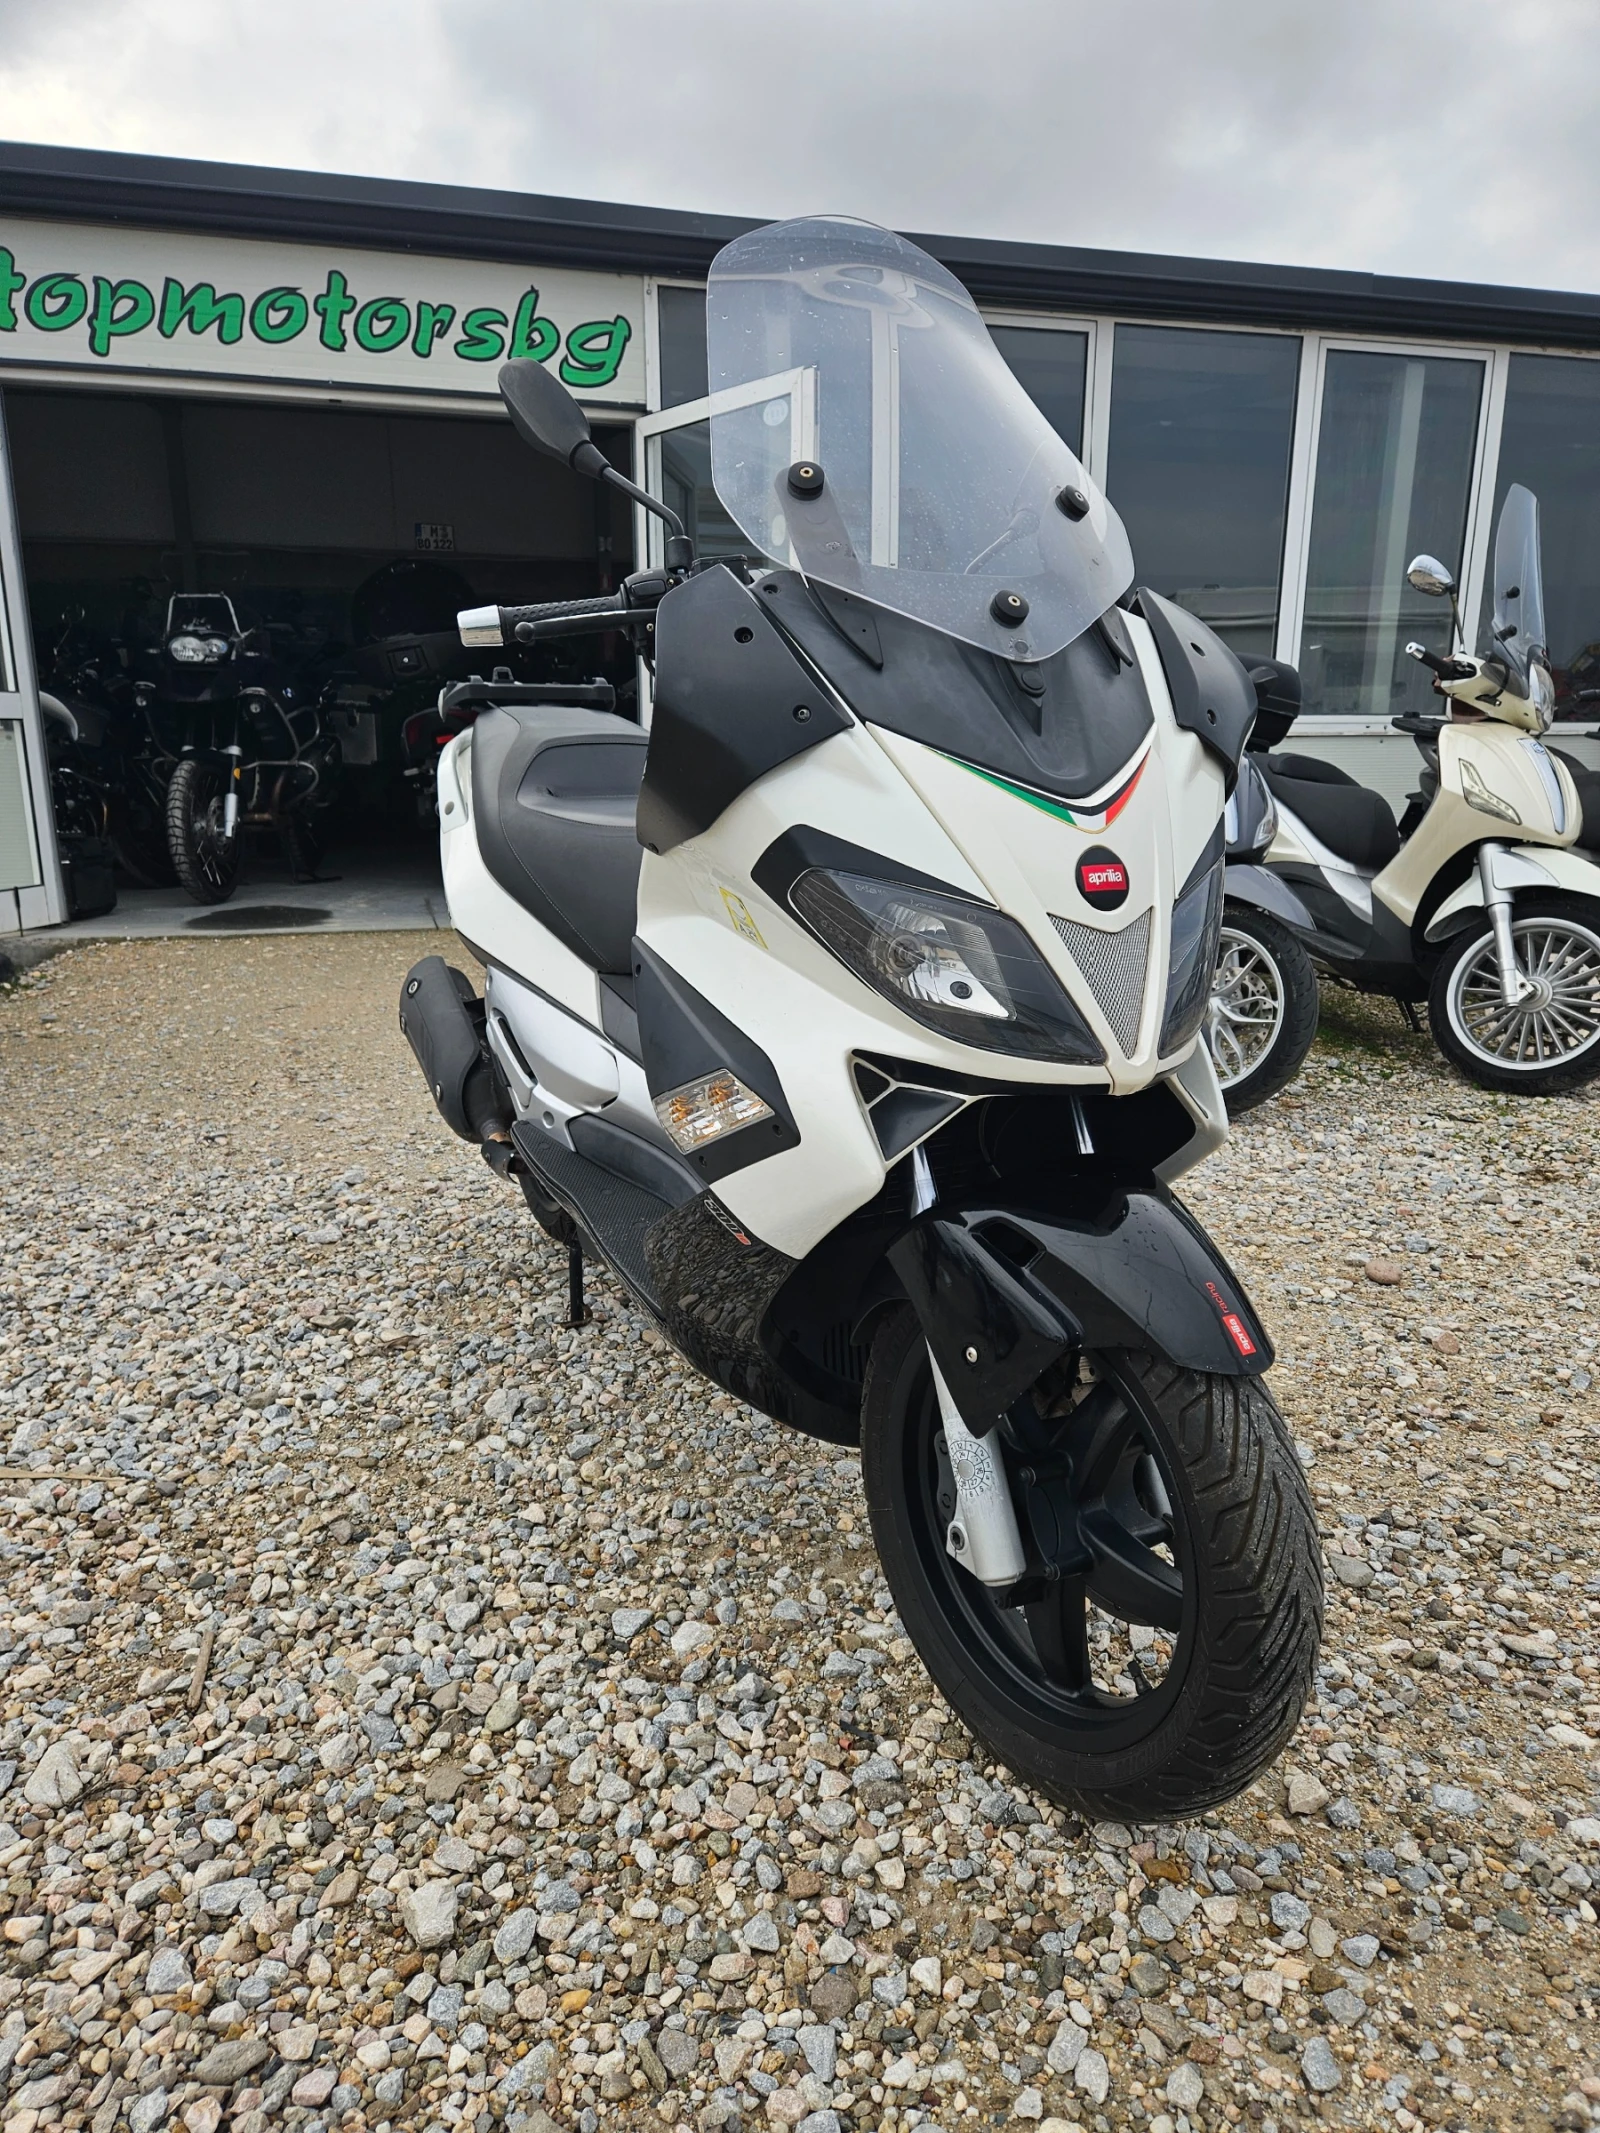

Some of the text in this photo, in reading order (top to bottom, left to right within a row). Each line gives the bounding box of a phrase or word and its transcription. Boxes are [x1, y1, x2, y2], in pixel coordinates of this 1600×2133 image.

[0, 246, 632, 388] topmotorsbg
[433, 538, 452, 549] 122
[1088, 868, 1123, 886] aprilia
[1205, 1282, 1251, 1350] aprilia racing
